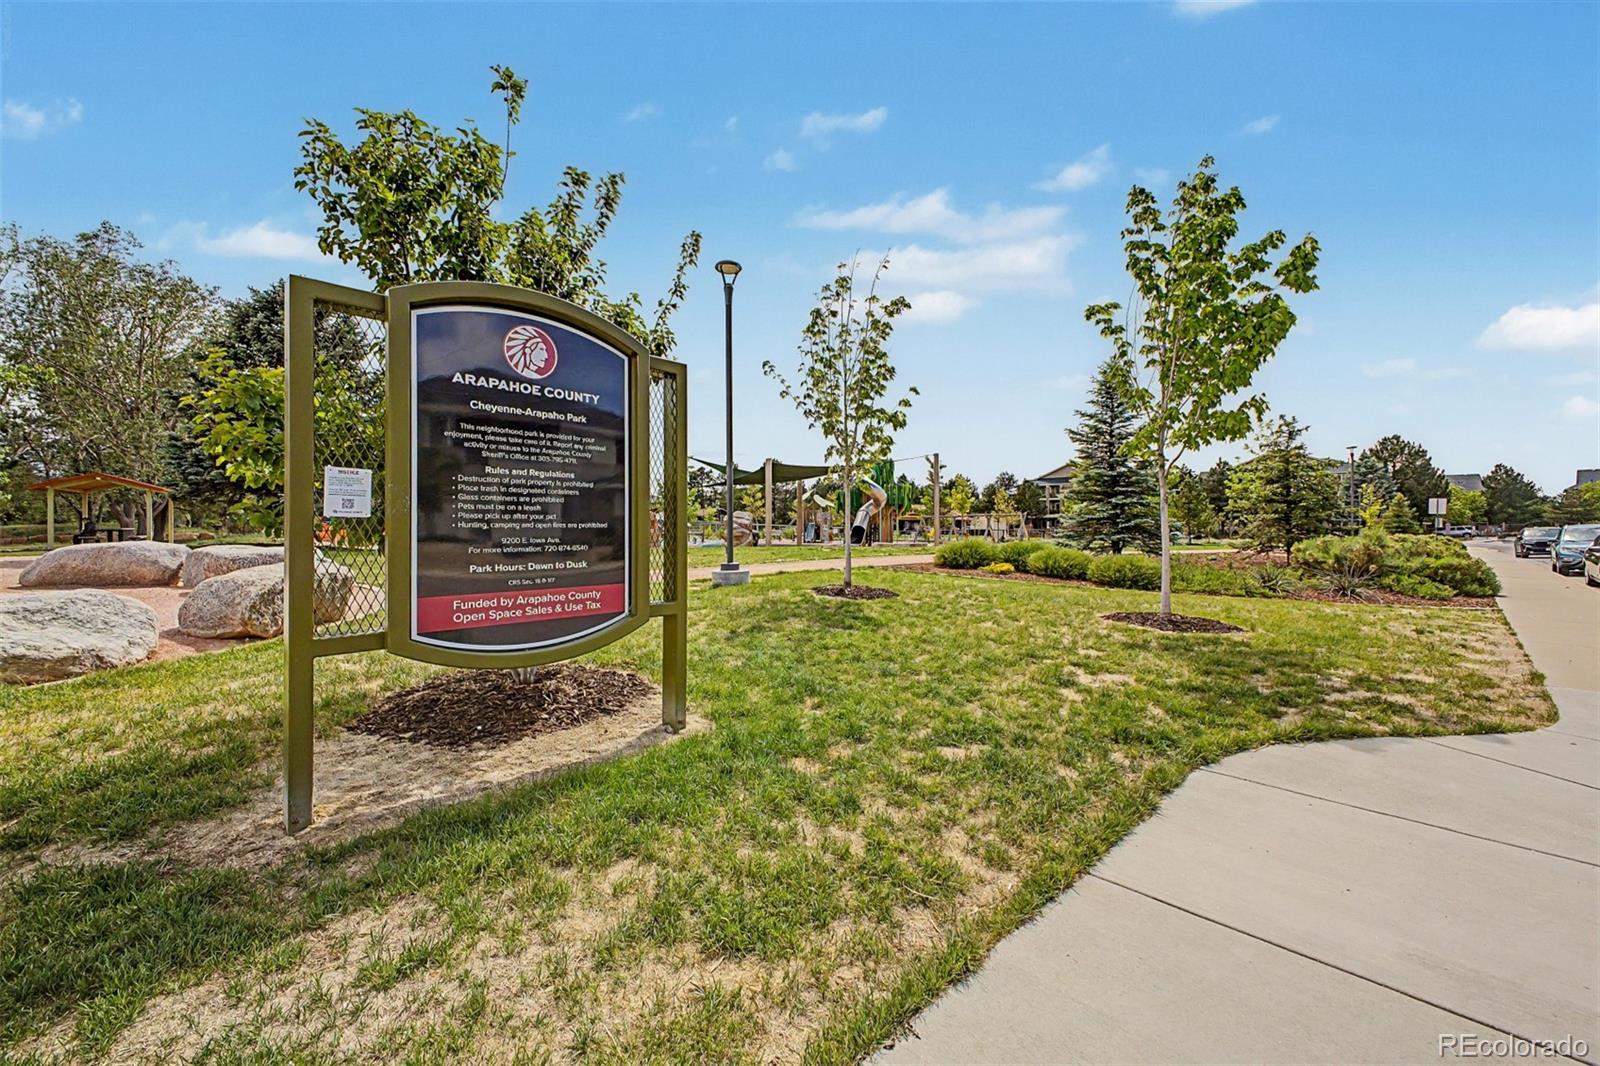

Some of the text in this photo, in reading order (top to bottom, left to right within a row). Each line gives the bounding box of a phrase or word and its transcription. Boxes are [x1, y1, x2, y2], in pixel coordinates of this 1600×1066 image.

[452, 372, 600, 405] ARAPAHOE COUNTY
[470, 400, 587, 423] Cheyenne-Arapaho Park
[460, 422, 475, 430] This
[476, 426, 524, 436] neighborhood
[546, 432, 572, 440] provided
[464, 441, 488, 450] activity
[542, 448, 570, 456] Arapahoe
[572, 450, 592, 458] County
[553, 441, 572, 449] Report
[458, 474, 500, 482] Destruction
[485, 466, 510, 474] Rules
[529, 468, 576, 478] Regulations
[508, 486, 546, 494] designated
[458, 521, 490, 530] Hunting,
[470, 564, 492, 573] Park
[494, 563, 526, 572] Hours:
[528, 562, 554, 570] Dawn
[566, 560, 588, 568] Dusk
[453, 590, 602, 610] Funded by Arapahoe County
[453, 600, 602, 624] Open Space Sales & Use Tax
